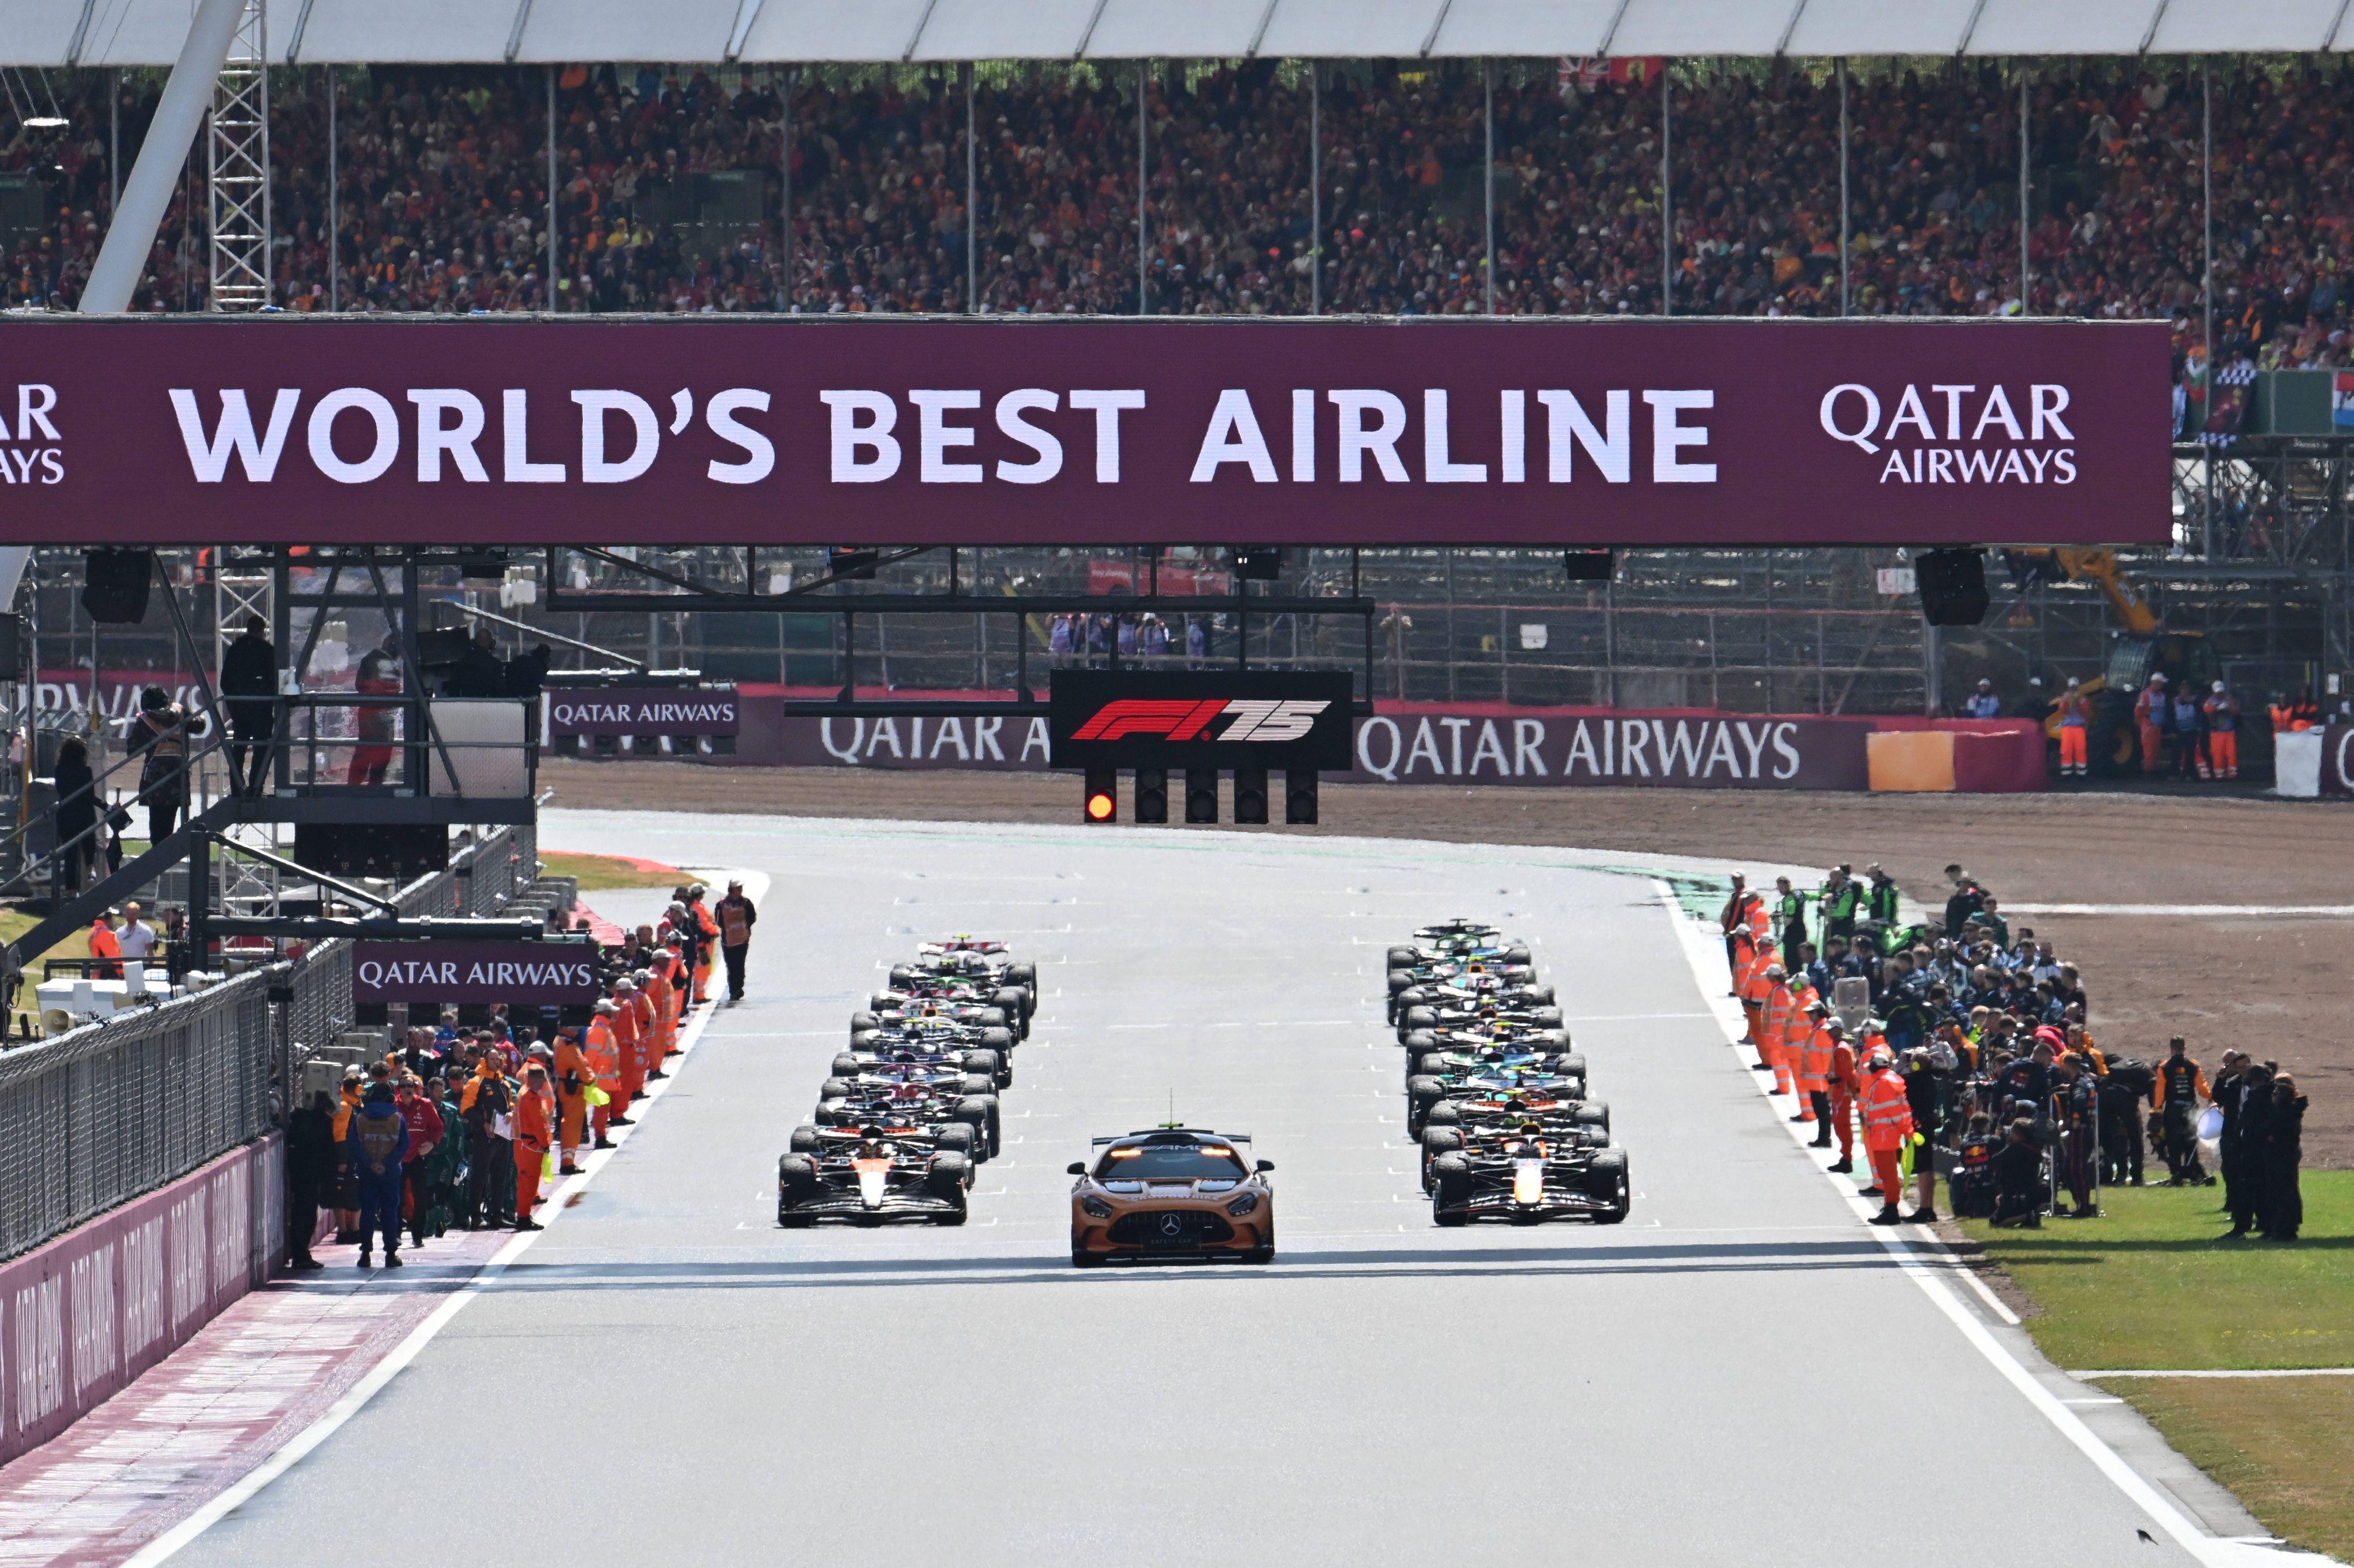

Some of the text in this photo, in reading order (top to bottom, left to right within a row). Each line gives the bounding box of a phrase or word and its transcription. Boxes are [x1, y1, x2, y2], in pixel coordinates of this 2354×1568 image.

[820, 388, 1146, 484] BEST
[1190, 388, 1717, 483] AIRLINE
[1820, 384, 2075, 454] QATAR
[1880, 448, 2077, 484] AIRWAYS
[554, 704, 734, 725] QATAR AIRWAYS
[822, 718, 1005, 764] QATAR
[1357, 715, 1800, 781] QATAR AIRWAYS
[359, 961, 592, 989] QATAR AIRWAYS
[1131, 1194, 1219, 1203] CROWDSTRIKE
